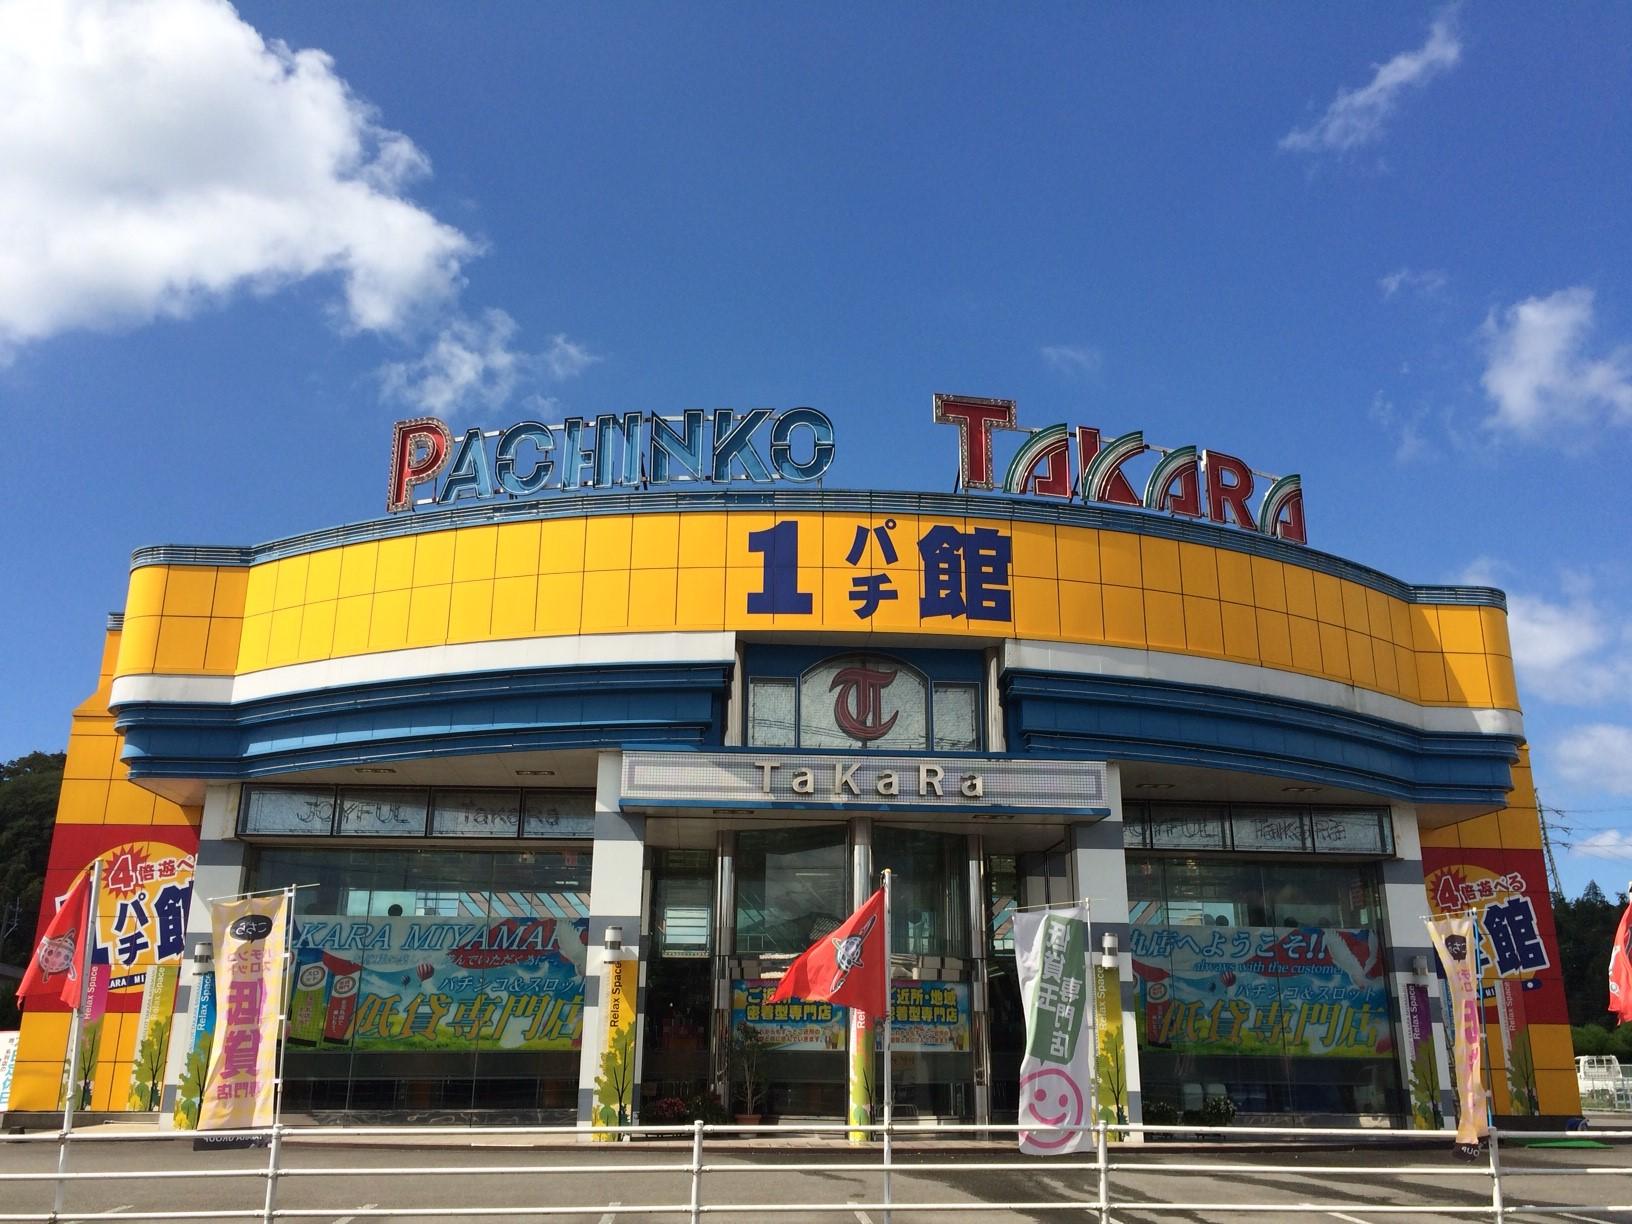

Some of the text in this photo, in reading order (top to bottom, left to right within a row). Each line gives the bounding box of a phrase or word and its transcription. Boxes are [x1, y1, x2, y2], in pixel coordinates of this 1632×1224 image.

[389, 393, 1308, 545] PACHINKO TAKARA
[747, 518, 1012, 622] 1パチ館
[754, 761, 984, 798] TaKaRa
[296, 801, 411, 824] JOYFUL
[108, 854, 197, 892] 4倍遊べ
[87, 966, 98, 992] Space
[154, 967, 165, 994] Space
[1267, 961, 1289, 972] the
[610, 962, 623, 1027] Relax Space
[1096, 967, 1107, 1031] Relax Space
[1409, 985, 1418, 1013] Space
[1504, 981, 1517, 1031] Relax Space
[197, 1003, 208, 1031] Relax
[1412, 1014, 1421, 1040] Relax
